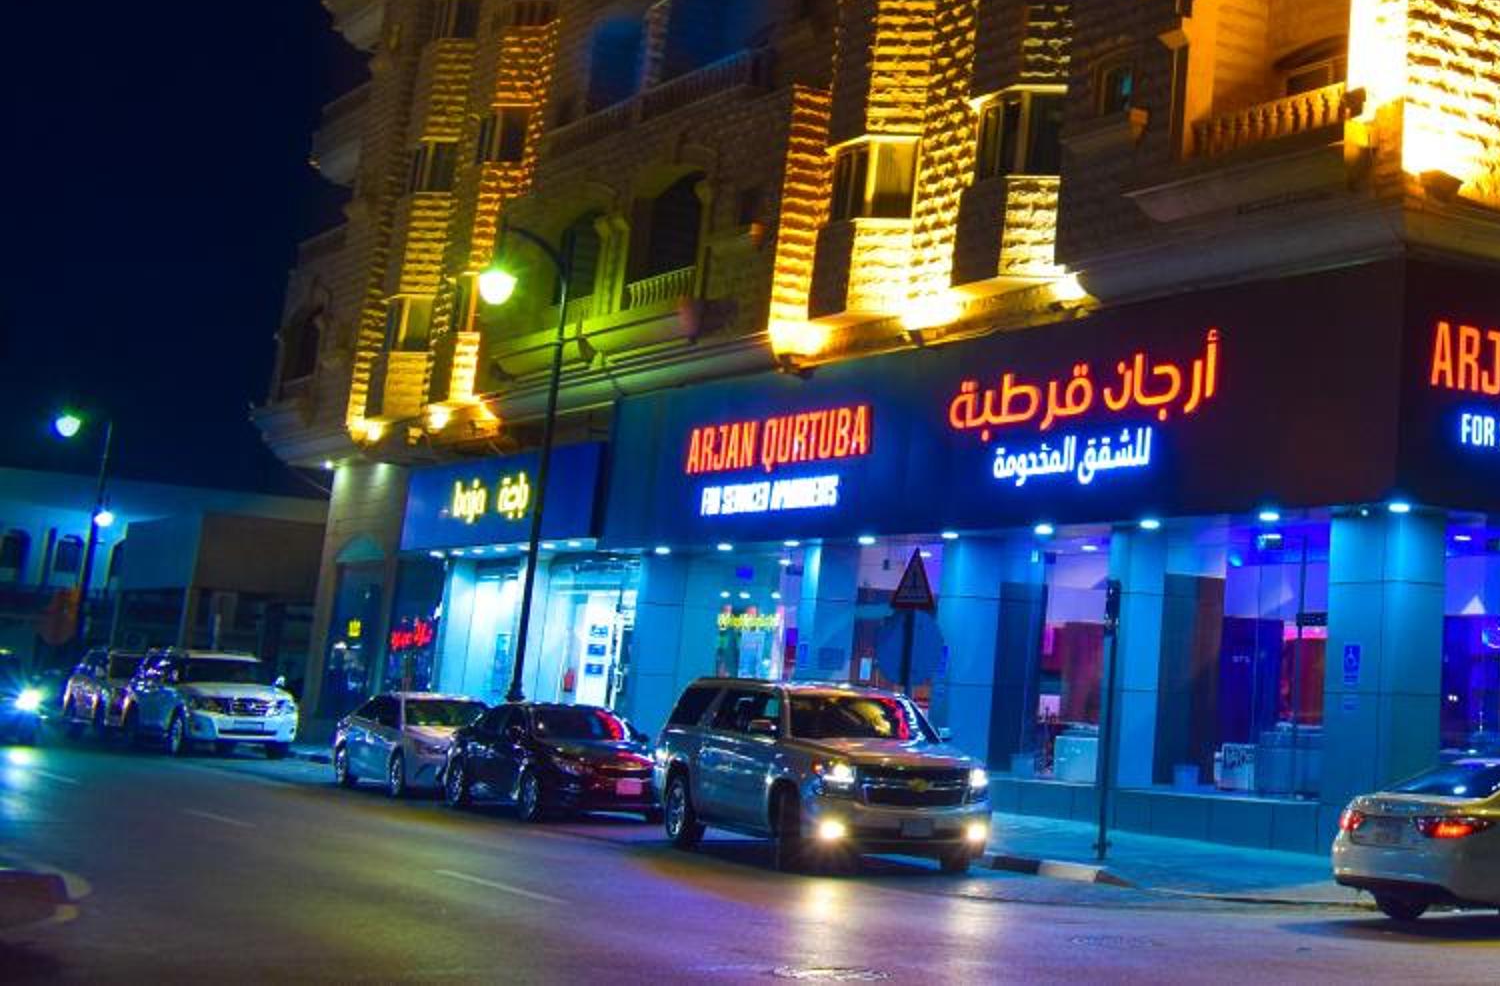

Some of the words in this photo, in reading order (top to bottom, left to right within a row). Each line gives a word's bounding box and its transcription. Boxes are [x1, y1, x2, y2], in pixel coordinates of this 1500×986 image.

[949, 363, 1094, 442] قرطبة
[1103, 328, 1220, 422] أرجان
[686, 421, 760, 474] ARJAN
[761, 405, 870, 474] QURTUBA
[992, 435, 1078, 487] المخدومة
[1077, 426, 1153, 485] للشقق
[1461, 412, 1495, 448] FOR
